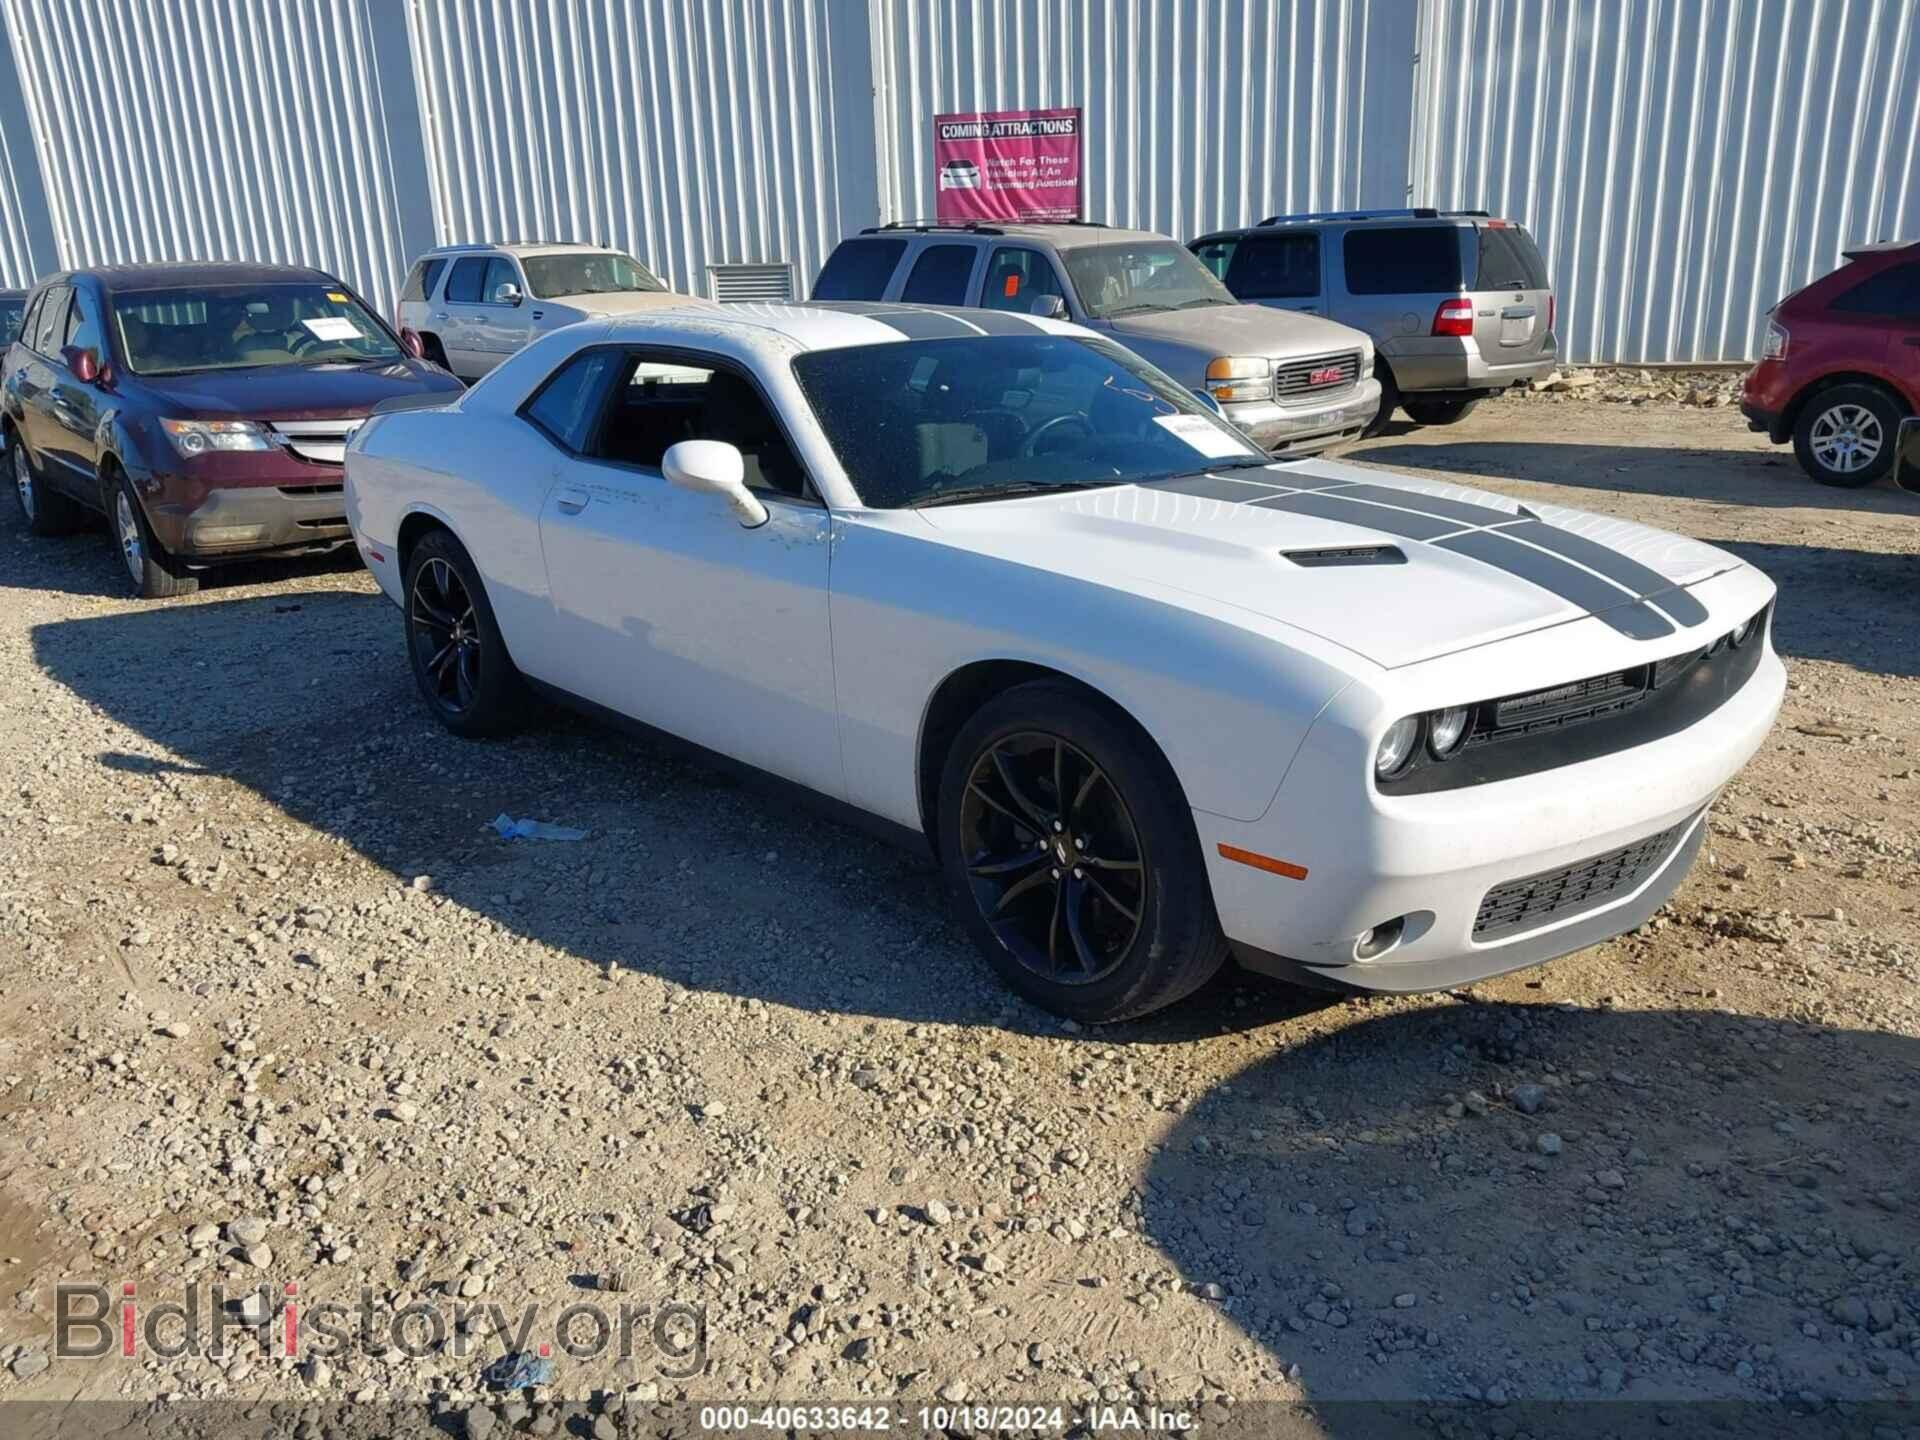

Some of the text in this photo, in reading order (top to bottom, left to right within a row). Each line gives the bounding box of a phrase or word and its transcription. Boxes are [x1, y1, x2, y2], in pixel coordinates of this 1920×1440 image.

[942, 119, 1073, 138] COMING ATTRACTIONS
[1019, 156, 1036, 166] For
[1040, 156, 1069, 165] These
[1046, 167, 1061, 176] An
[1036, 177, 1078, 187] Auction!
[1310, 368, 1344, 384] GMC
